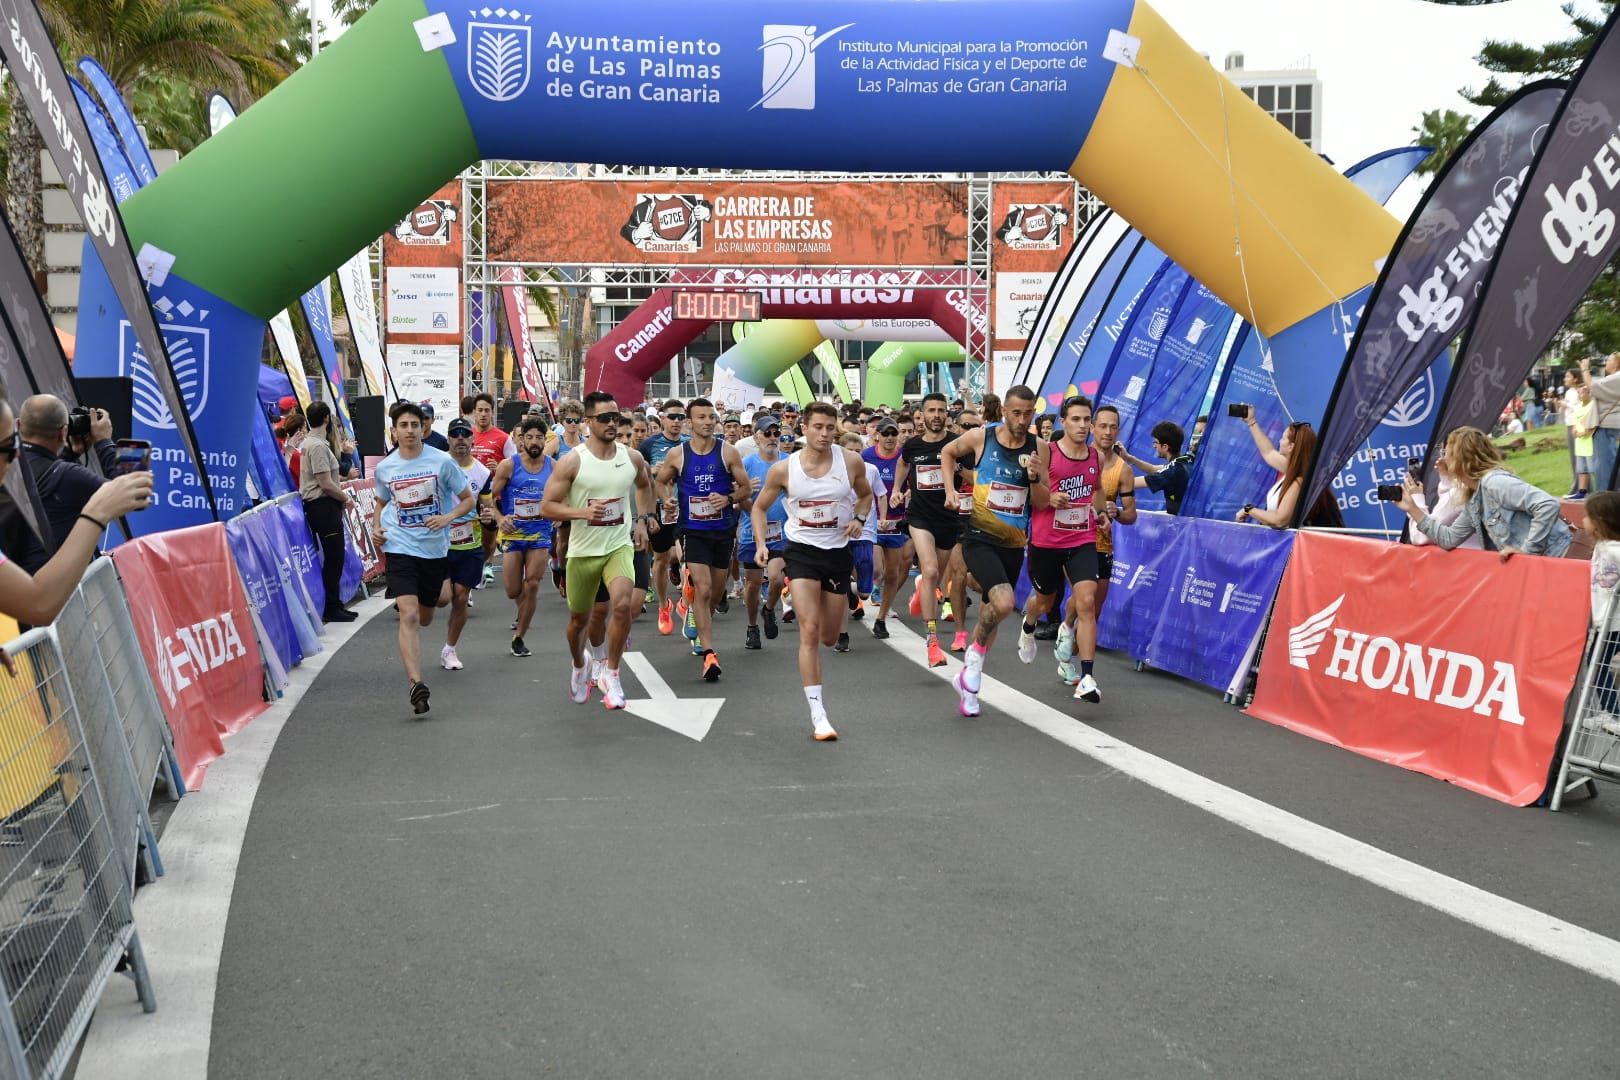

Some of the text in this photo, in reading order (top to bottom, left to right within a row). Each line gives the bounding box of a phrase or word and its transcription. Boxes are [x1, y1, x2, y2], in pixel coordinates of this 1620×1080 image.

[546, 31, 721, 56] Ayuntamiento
[838, 38, 1088, 56] Instituto Municipal para la Promoción
[546, 53, 721, 79] de Las Palmas
[840, 55, 1087, 73] de la Actividad Física y el Deporte de
[546, 78, 720, 103] de Gran Canaria
[858, 77, 1067, 93] Las Palmas de Gran Canaria
[714, 196, 814, 217] CARRERA DE
[659, 210, 683, 226] #C7CE
[714, 219, 833, 240] LAS EMPRESAS
[405, 236, 440, 245] Canarias
[714, 242, 831, 253] LAS PALMAS DE GRAN CANARIA
[1014, 242, 1050, 250] Canarias
[391, 316, 417, 325] Binter
[891, 319, 931, 328] Europea
[694, 474, 715, 484] PEPE
[1059, 474, 1084, 491] 3COM
[1332, 466, 1407, 489] de Las
[1337, 492, 1361, 511] de
[1325, 628, 1526, 726] HONDA
